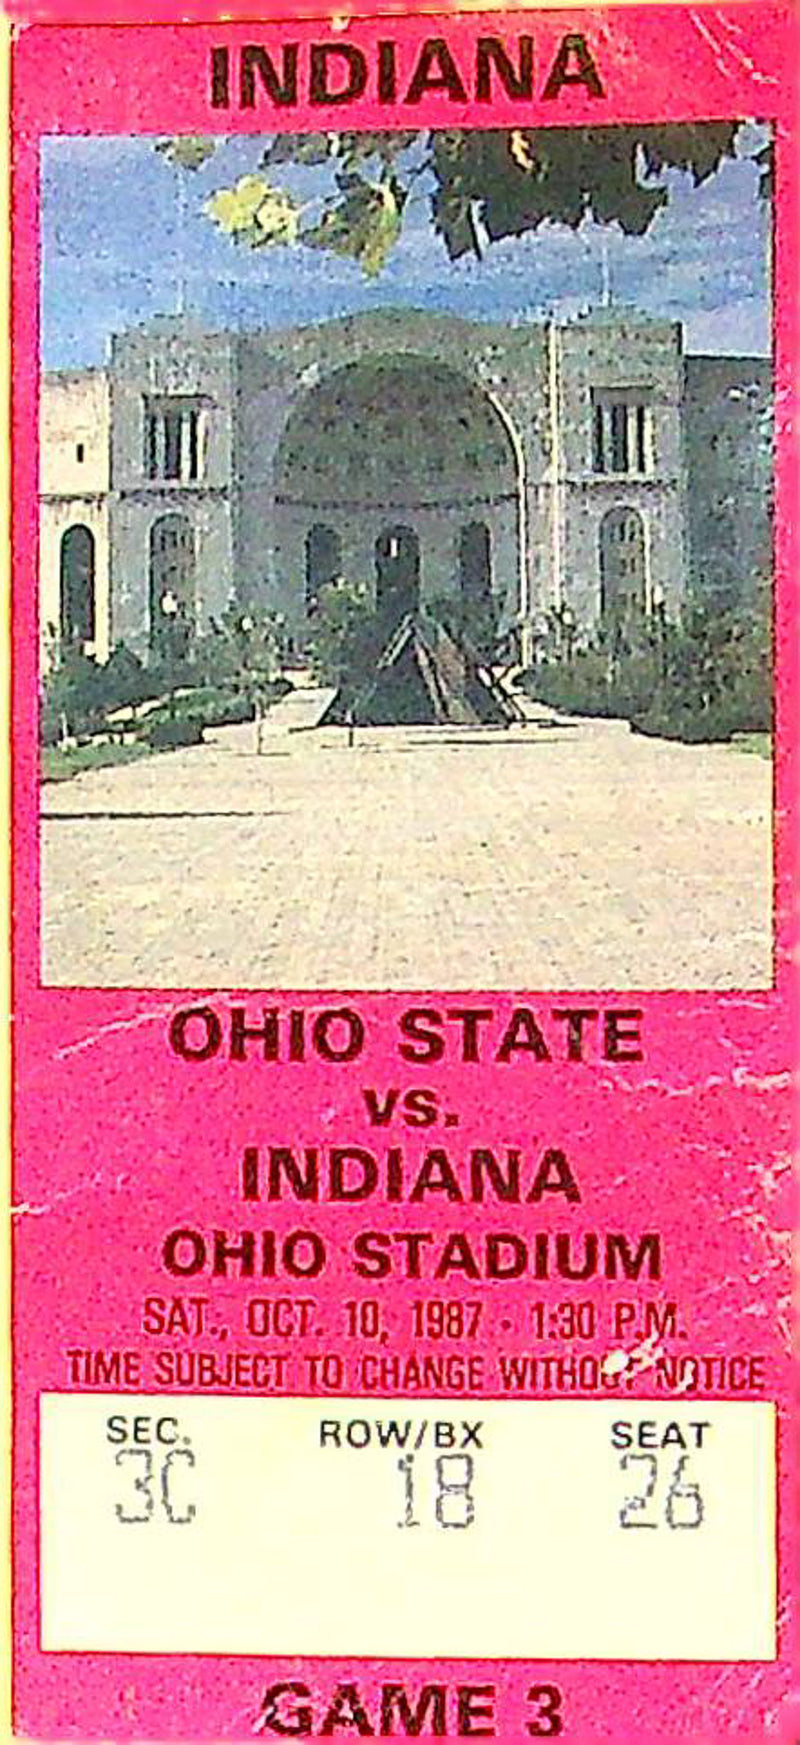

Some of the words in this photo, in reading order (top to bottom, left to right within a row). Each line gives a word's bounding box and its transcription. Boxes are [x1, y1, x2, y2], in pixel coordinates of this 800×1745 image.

[209, 33, 607, 109] INDIANA
[169, 1007, 365, 1063] OHIO
[400, 1007, 645, 1063] STATE
[241, 1147, 582, 1203] INDIANA
[162, 1229, 326, 1278] OHIO
[353, 1231, 662, 1281] STADIUM
[142, 1298, 229, 1342] SAT.,
[246, 1299, 325, 1339] OCT.
[346, 1300, 390, 1345] 10,
[412, 1301, 483, 1340] 1987
[532, 1302, 596, 1341] 1:30
[615, 1303, 689, 1342] P.M.
[67, 1350, 141, 1386] TIME
[155, 1351, 287, 1387] SUBJECT
[303, 1351, 344, 1388] TO
[361, 1353, 484, 1390] CHANGE
[654, 1353, 766, 1391] NOTICE
[106, 1416, 192, 1445] SEC.
[318, 1420, 485, 1449] ROW/BX
[610, 1421, 712, 1450] SEAT
[397, 1454, 475, 1528] 18
[619, 1455, 705, 1529] 26
[260, 1682, 498, 1737] GAME
[526, 1684, 564, 1737] 3
